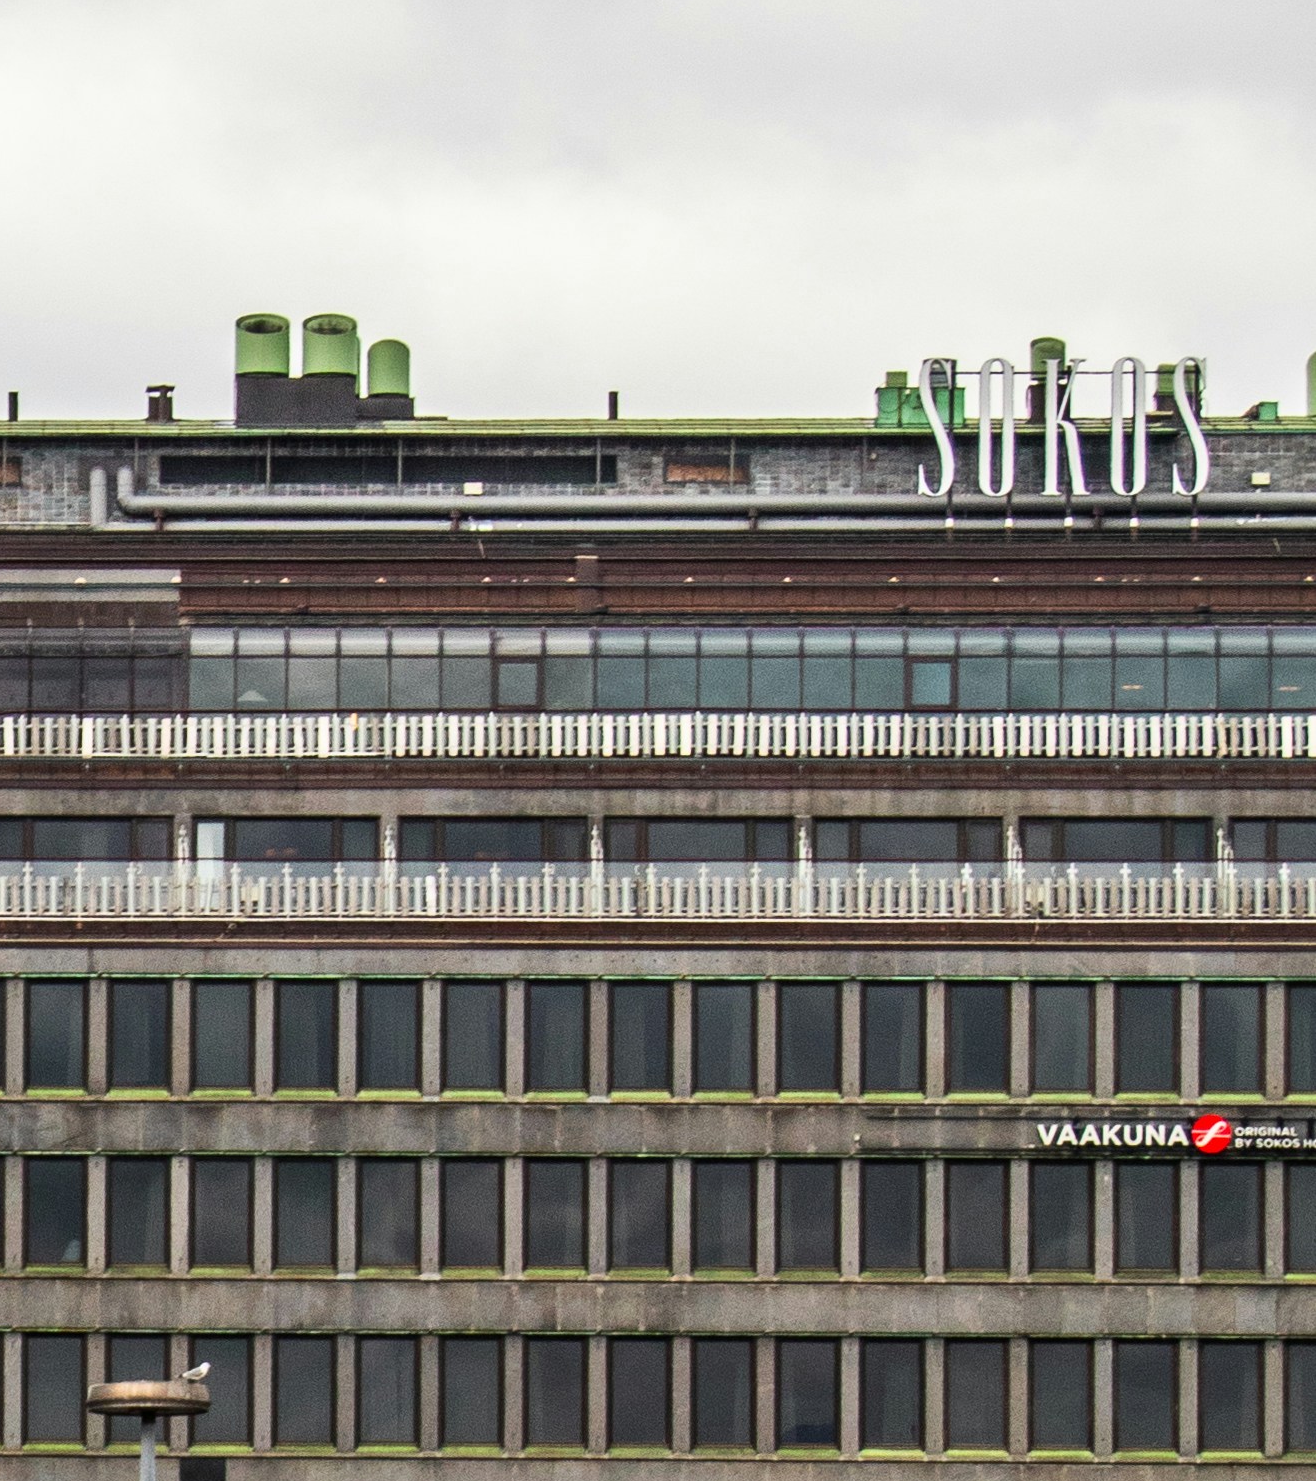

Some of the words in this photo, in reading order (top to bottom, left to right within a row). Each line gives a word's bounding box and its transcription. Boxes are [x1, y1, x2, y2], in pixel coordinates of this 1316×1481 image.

[917, 356, 1209, 497] SOKOS
[1037, 1123, 1189, 1147] VAAKUNA
[1234, 1126, 1298, 1137] ORIGINAL
[1234, 1138, 1252, 1149] BY
[1256, 1138, 1301, 1149] SOKOS
